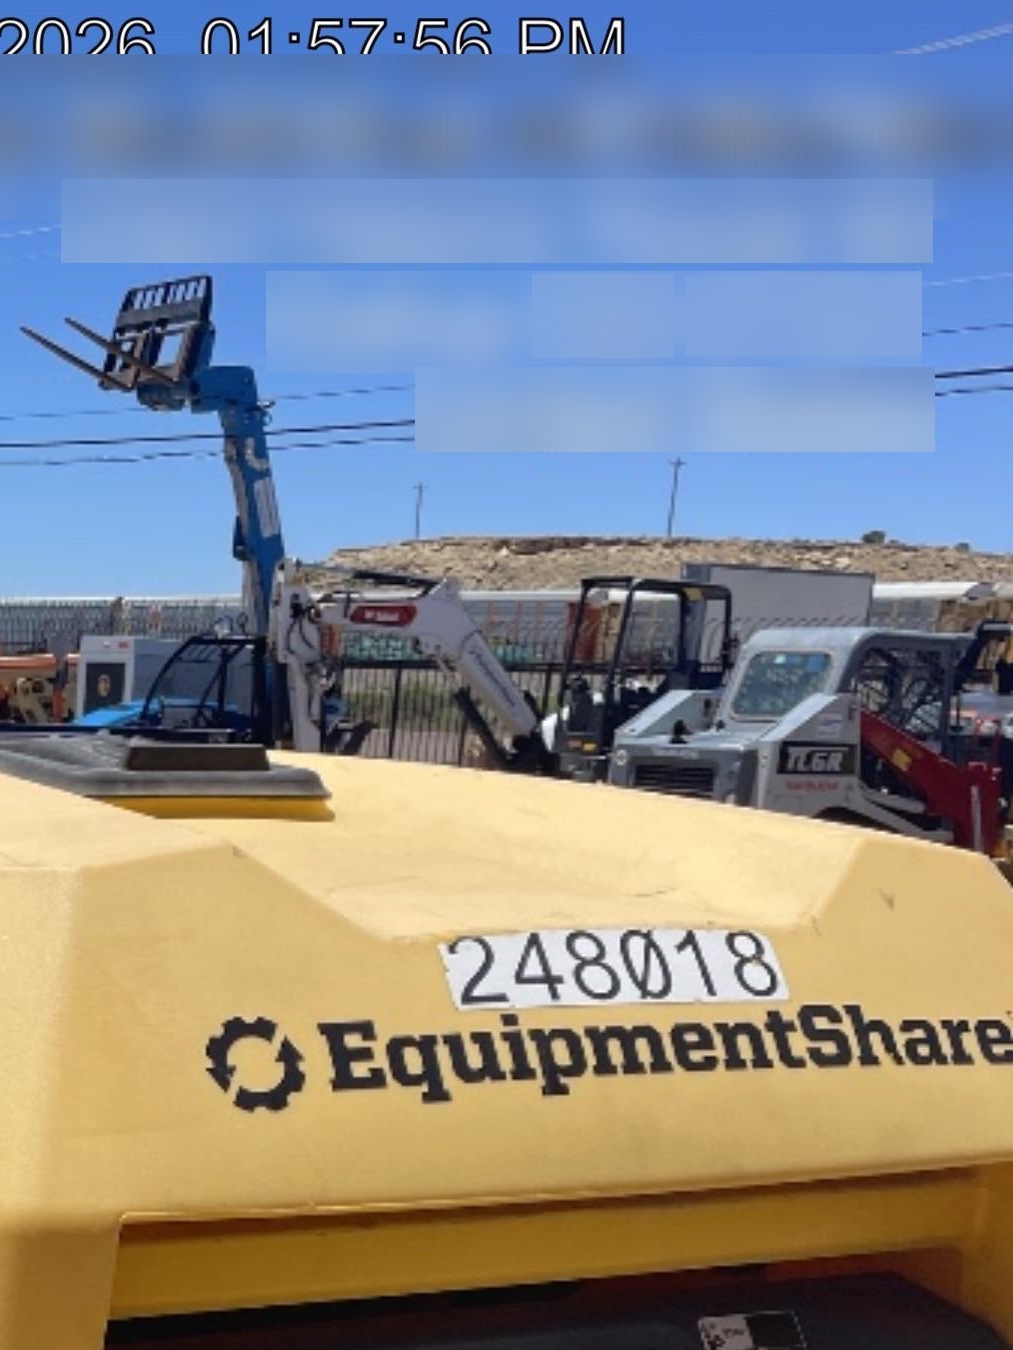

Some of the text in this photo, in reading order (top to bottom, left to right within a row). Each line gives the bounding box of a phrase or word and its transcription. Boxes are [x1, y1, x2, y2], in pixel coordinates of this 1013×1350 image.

[786, 746, 845, 773] TL6R
[448, 928, 779, 1005] 248018
[318, 1005, 1013, 1102] EquipmentShare
